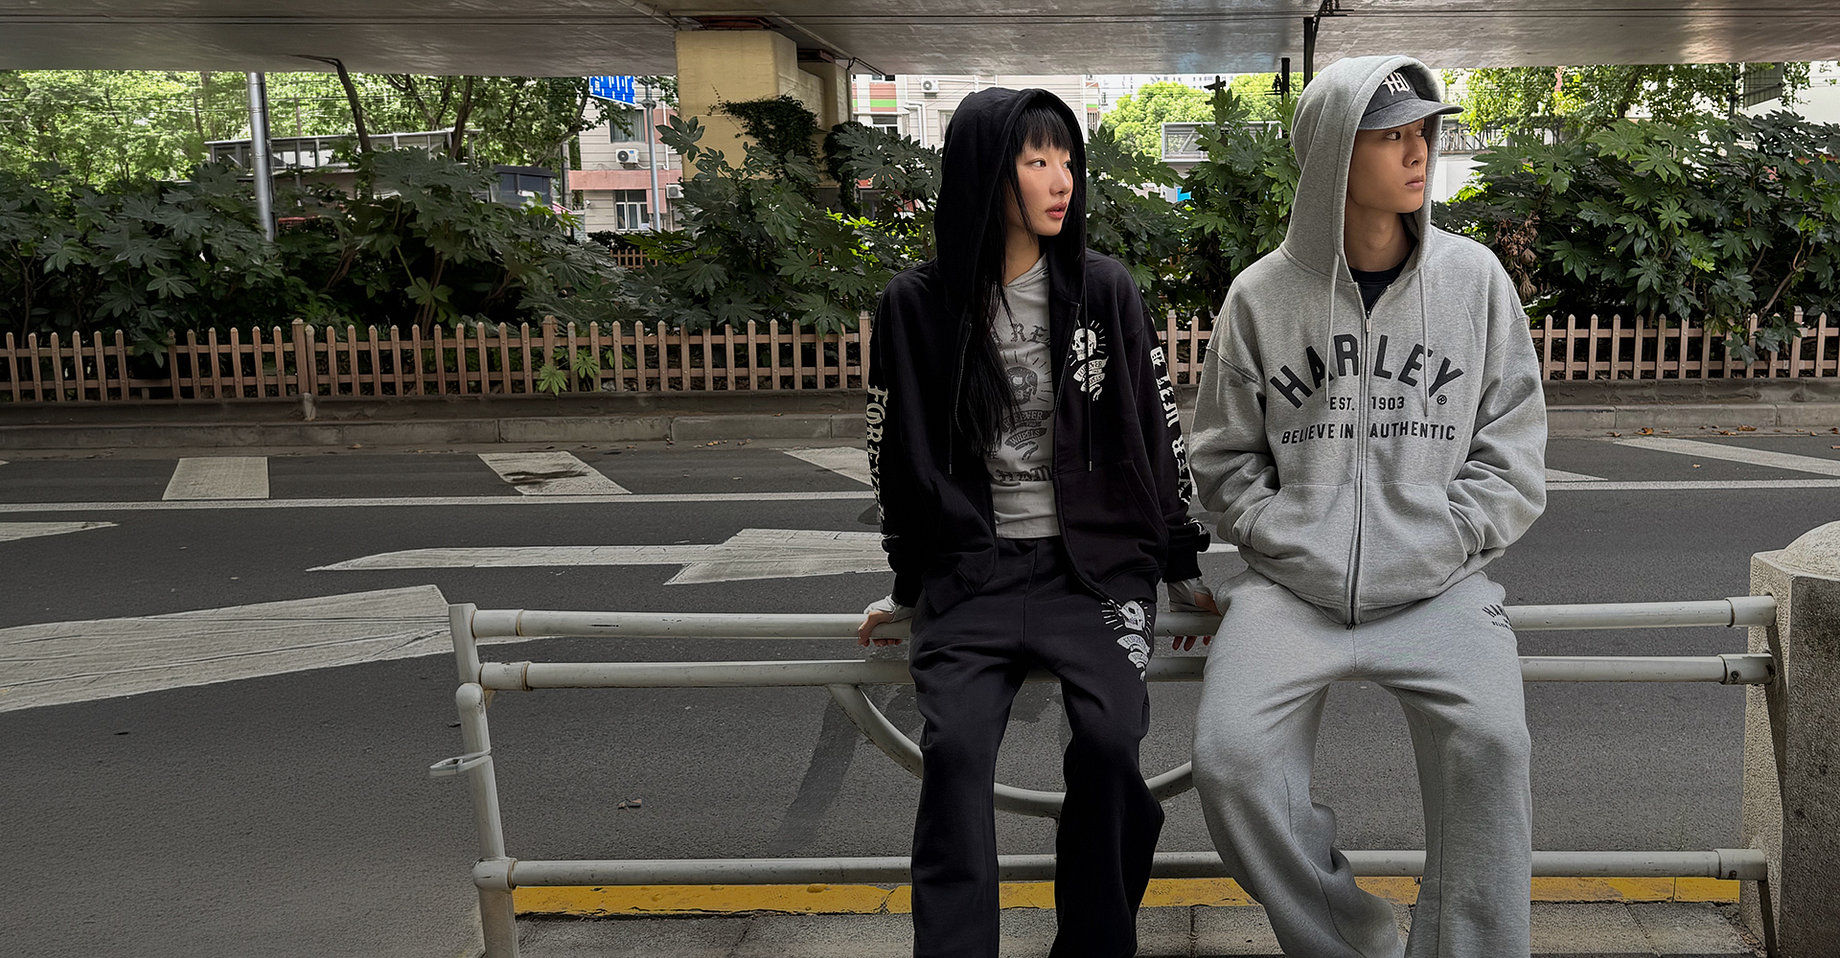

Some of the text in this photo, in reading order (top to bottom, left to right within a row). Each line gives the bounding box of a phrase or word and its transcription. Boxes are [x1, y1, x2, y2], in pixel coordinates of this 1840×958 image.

[1329, 396, 1405, 411] EST. 1903
[1281, 421, 1456, 445] BELIEVE IN AUTHENTIC
